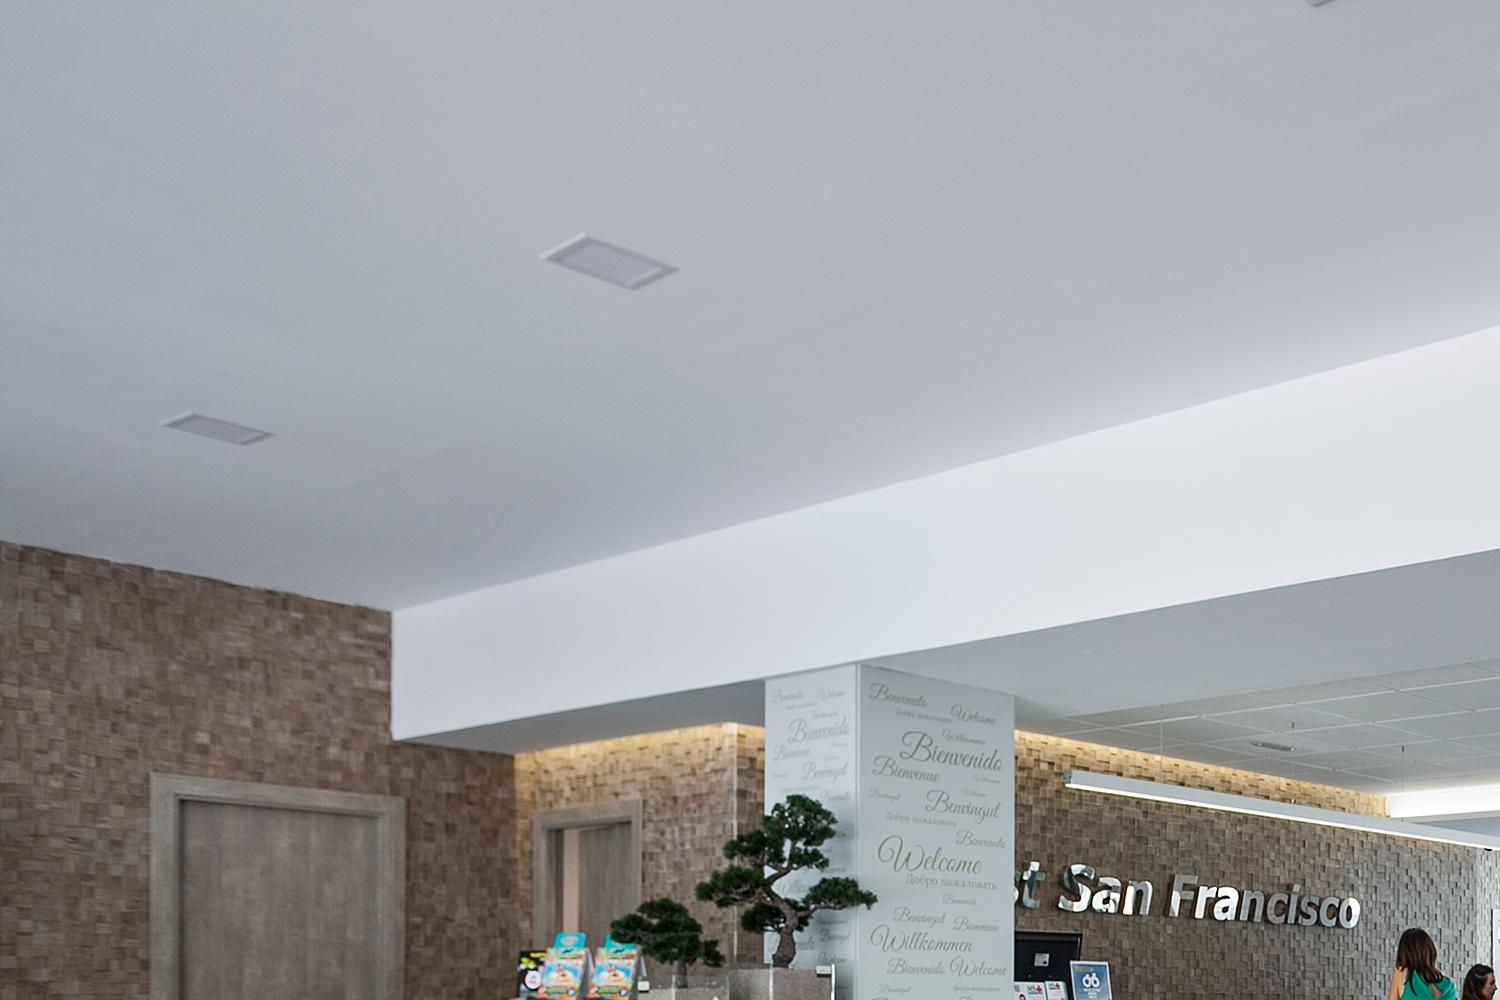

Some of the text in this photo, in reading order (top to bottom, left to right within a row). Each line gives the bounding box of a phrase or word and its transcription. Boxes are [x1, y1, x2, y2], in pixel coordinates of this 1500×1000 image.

[951, 703, 997, 725] Welcome
[899, 730, 1006, 772] Bienvenido
[871, 755, 940, 783] Bienvenue
[924, 789, 1002, 824] Benvingut
[877, 835, 983, 874] Welcome
[905, 873, 998, 891] Добро пожаловать
[1058, 863, 1155, 917] San
[1168, 873, 1362, 930] Francisco
[870, 924, 976, 953] Willkommen
[950, 956, 1008, 977] Welcome
